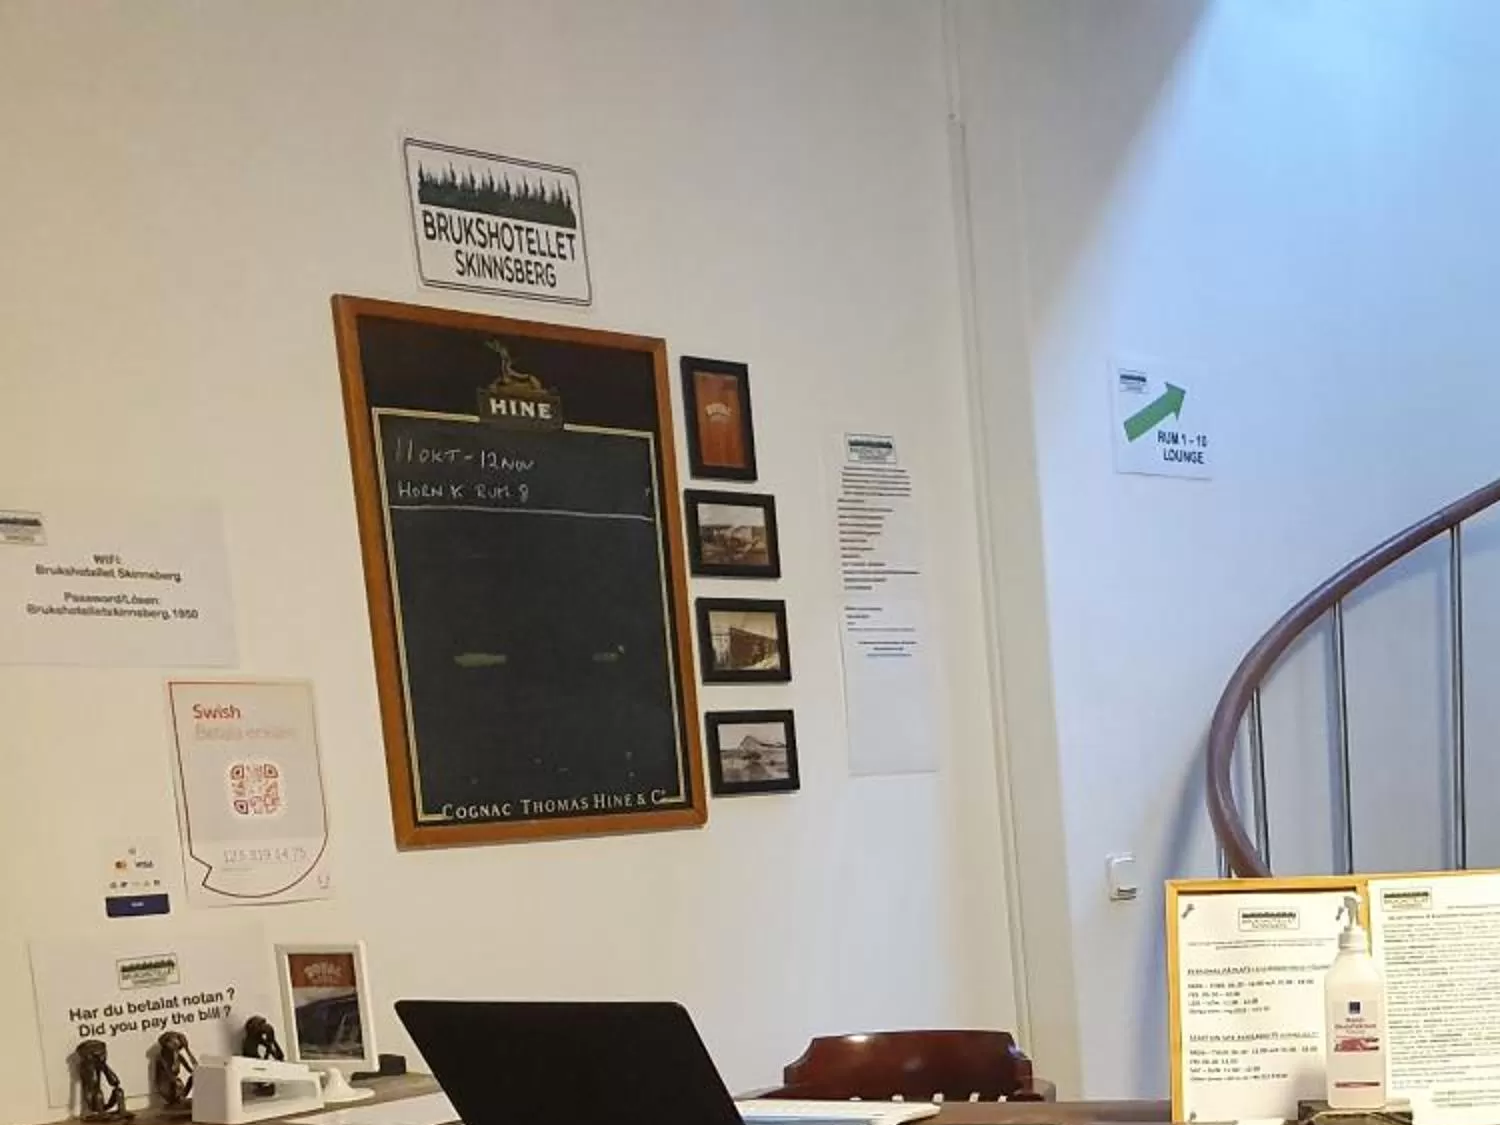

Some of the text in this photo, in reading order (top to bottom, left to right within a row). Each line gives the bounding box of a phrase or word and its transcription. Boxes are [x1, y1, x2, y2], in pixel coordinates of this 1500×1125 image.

[423, 210, 576, 260] BRUKSHOTELLET
[455, 249, 557, 287] SKINNSBERG
[489, 397, 552, 419] HINE
[1157, 430, 1179, 445] RUM
[1163, 448, 1204, 464] LOUNGE
[193, 704, 241, 719] Swish
[442, 803, 511, 820] COGNAC
[520, 798, 589, 815] THOMAS
[593, 793, 635, 809] HINE
[69, 987, 235, 1022] Har du betalat notan ?
[79, 1005, 232, 1038] Did you pay the bill ?
